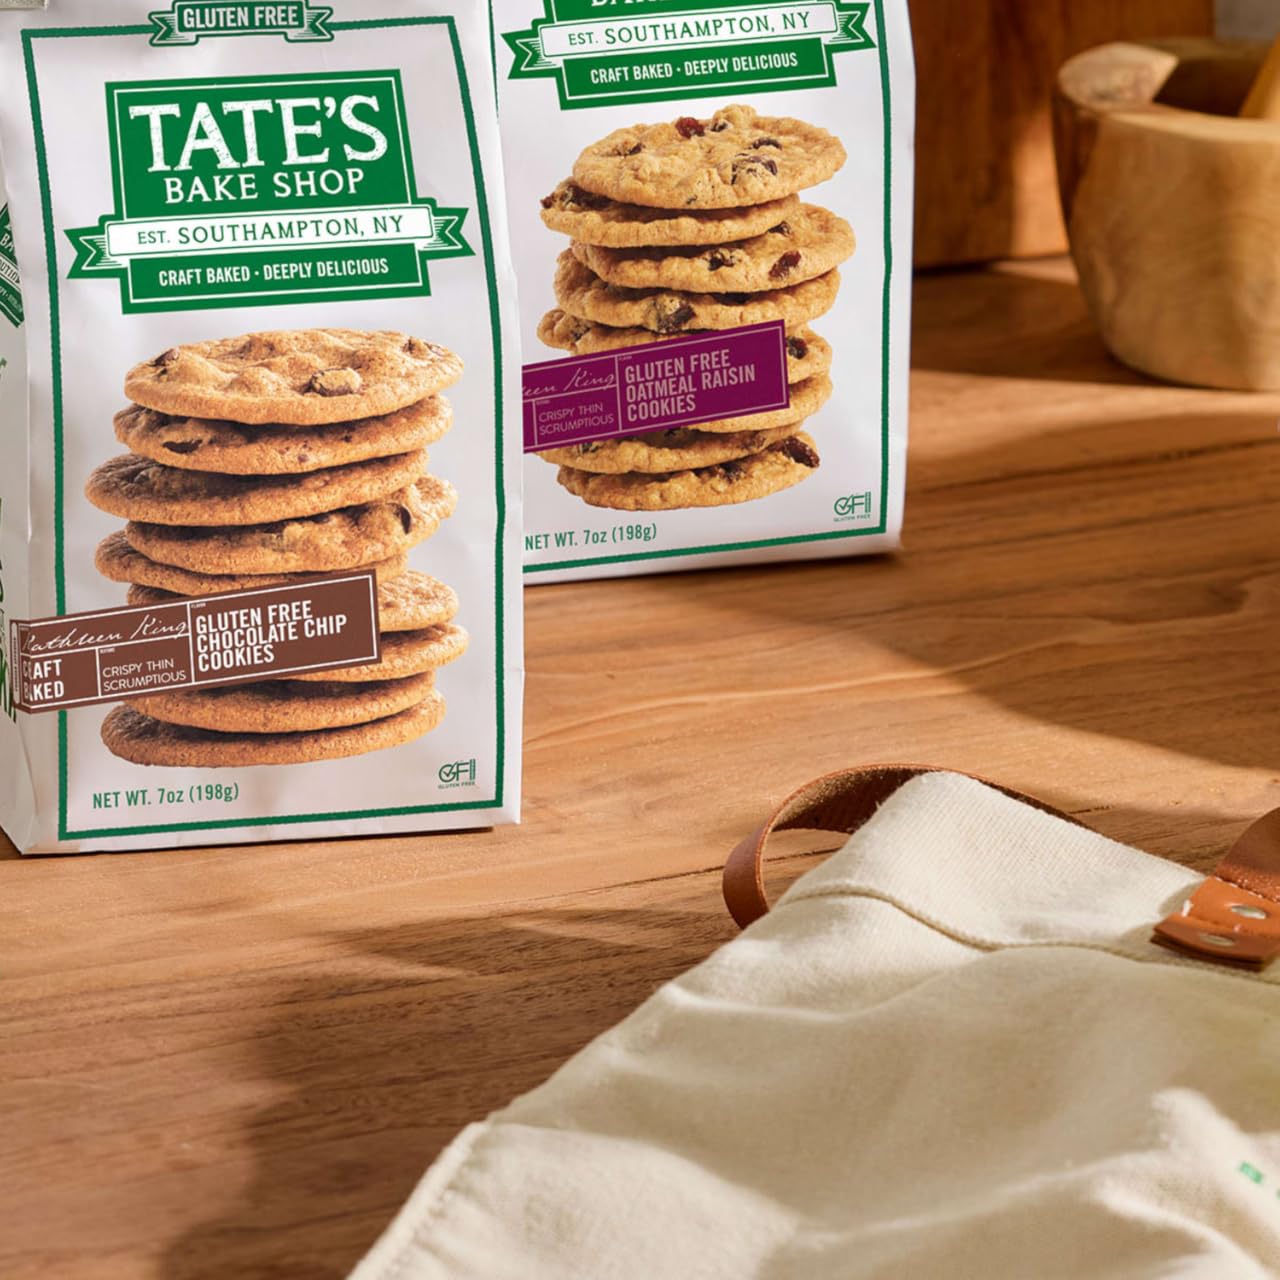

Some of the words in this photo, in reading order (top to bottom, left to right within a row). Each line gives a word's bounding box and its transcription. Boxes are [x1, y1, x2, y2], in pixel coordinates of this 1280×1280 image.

[182, 7, 250, 30] GLUTEN
[253, 4, 299, 27] FREE
[567, 31, 600, 48] EST.
[604, 17, 776, 47] SOUTHAMPTON,
[782, 10, 811, 30] NY
[590, 65, 630, 85] CRAFT
[633, 61, 674, 81] BAKED
[683, 56, 730, 77] DEEPLY
[733, 52, 799, 73] DELICIOUS
[128, 94, 389, 173] TATE'S
[164, 173, 260, 206] BAKE
[273, 168, 366, 198] SHOP
[137, 228, 172, 246] EST.
[177, 217, 365, 246] SOUTHAMPTON,
[372, 214, 404, 235] NY
[158, 268, 203, 288] CRAFT
[206, 265, 251, 285] BAKED
[262, 261, 314, 282] DEEPLY
[317, 256, 390, 278] DELICIOUS
[563, 367, 614, 391] King
[625, 356, 685, 384] GLUTEN
[690, 349, 731, 373] FREE
[626, 375, 697, 403] OATMEAL
[702, 364, 756, 390] RAISIN
[538, 408, 575, 423] CRISPY
[578, 402, 604, 415] THIN
[628, 394, 696, 422] COOKIES
[539, 413, 614, 436] SCRUMPTIOUS
[524, 533, 552, 551] NET
[554, 531, 579, 549] WT.
[583, 528, 608, 545] 7oz
[611, 523, 658, 545] (198g)
[130, 614, 187, 640] King
[195, 607, 261, 634] GLUTEN
[268, 600, 313, 624] FREE
[196, 620, 299, 653] CHOCOLATE
[304, 614, 348, 638] CHIP
[102, 661, 143, 679] CRISPY
[146, 658, 175, 673] THIN
[198, 644, 275, 672] COOKIES
[103, 670, 187, 692] SCRUMPTIOUS
[92, 791, 122, 810] NET
[125, 789, 153, 808] WT.
[156, 786, 184, 805] 7oz
[188, 782, 240, 806] (198g)
